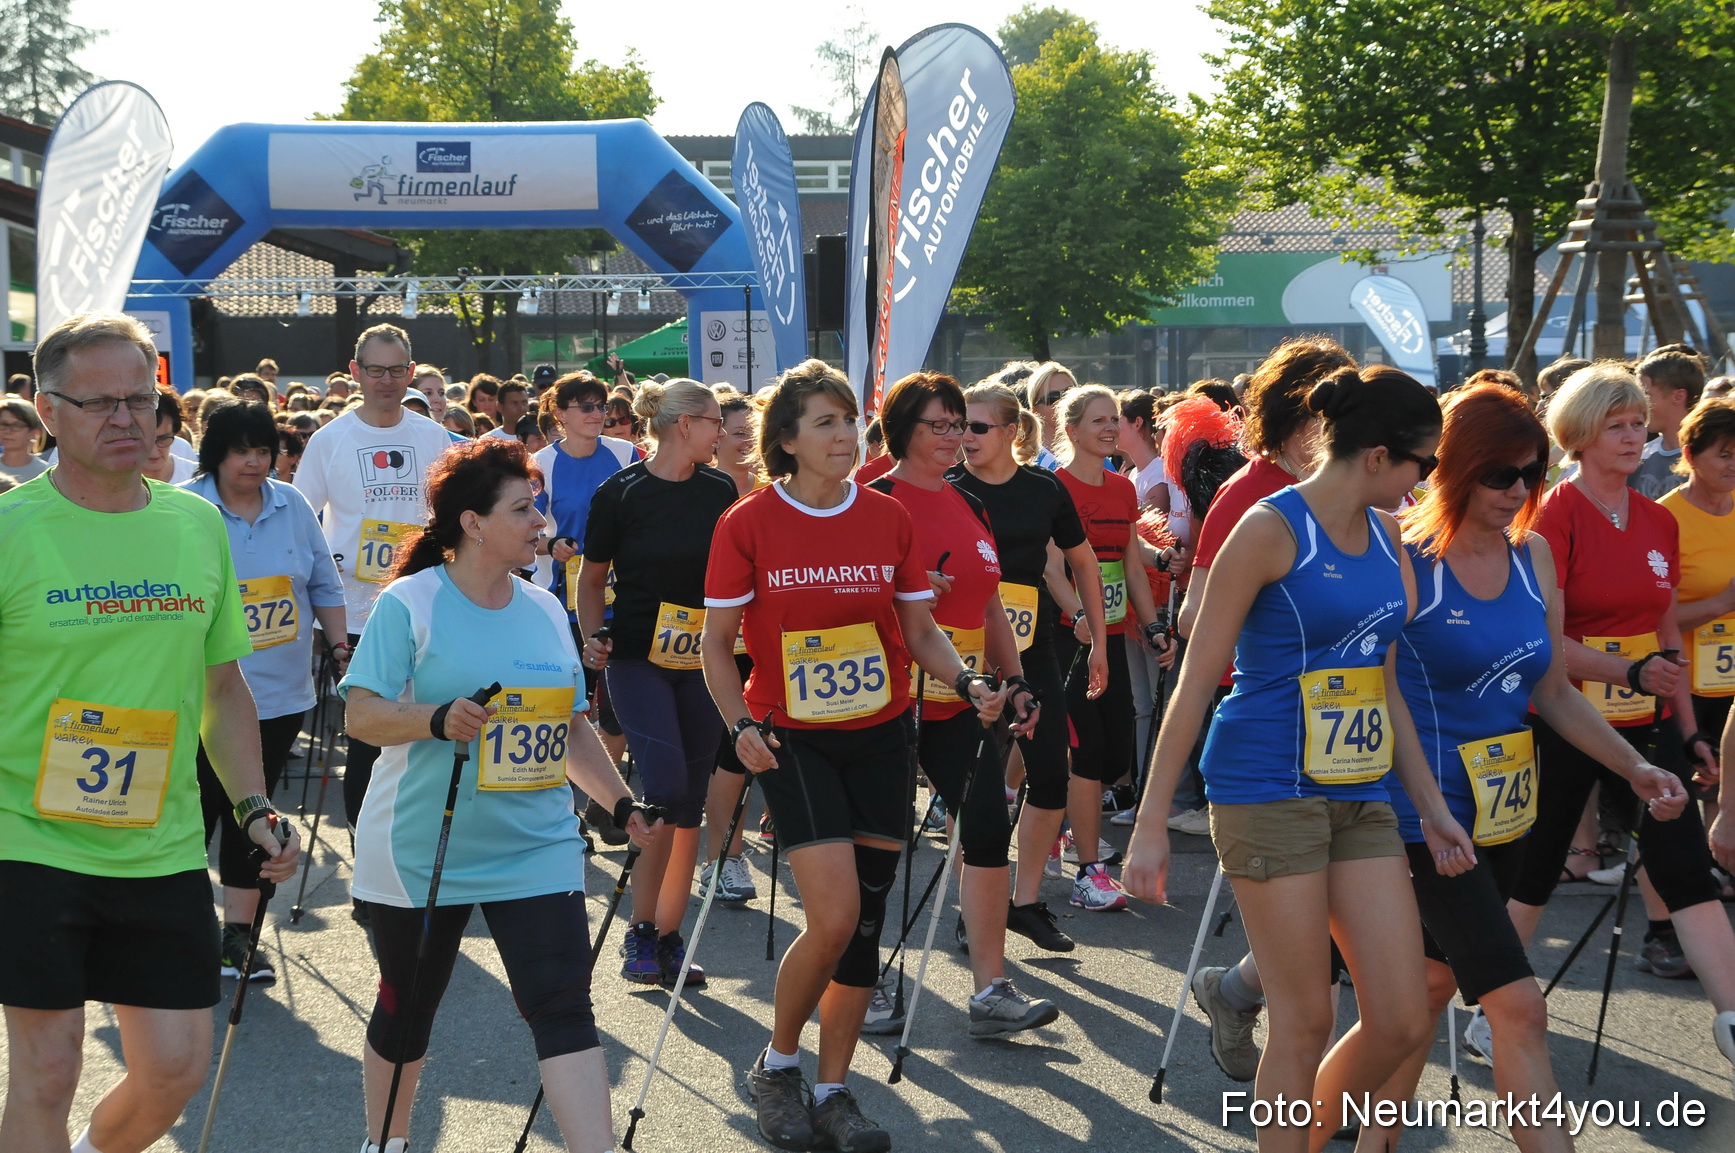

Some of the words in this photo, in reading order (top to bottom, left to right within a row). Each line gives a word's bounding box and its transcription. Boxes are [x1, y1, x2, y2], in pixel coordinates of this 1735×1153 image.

[428, 153, 468, 162] Fischer
[892, 67, 979, 269] Fischer
[398, 174, 518, 196] firmenlauf
[923, 103, 990, 264] AUTOMOBILE
[69, 118, 143, 288] Fischer
[398, 197, 447, 205] neumarkt
[161, 214, 229, 229] Fischer
[647, 214, 664, 225] und
[665, 212, 683, 221] das
[696, 220, 716, 229] mit!
[365, 486, 418, 498] POLGER
[362, 541, 405, 568] 10
[767, 565, 877, 588] NEUMARKT
[46, 580, 181, 604] autoladen
[86, 594, 206, 615] neumarkt
[49, 616, 90, 628] ersatzteil,
[93, 614, 115, 626] groß-
[117, 614, 133, 623] und
[243, 599, 295, 632] 372
[1329, 629, 1356, 652] Team
[1357, 606, 1386, 629] Schick
[1386, 599, 1404, 611] Bau
[798, 644, 836, 655] firmenlauf
[526, 662, 562, 672] sumida
[789, 657, 819, 666] walken
[1465, 670, 1491, 693] Team
[1492, 646, 1525, 670] Schick
[1525, 637, 1544, 650] Bau
[1715, 645, 1735, 674] 5
[789, 655, 885, 702] 1335
[1321, 687, 1357, 697] firmenlauf
[499, 704, 536, 713] firmenlauf
[1311, 701, 1341, 711] walken
[488, 715, 519, 724] walken
[70, 720, 121, 735] firmenlauf
[1320, 707, 1383, 755] 748
[54, 732, 93, 746] walken
[485, 723, 568, 764] 1388
[76, 747, 137, 796] 31
[1476, 768, 1503, 780] walken
[83, 795, 108, 805] Rainer
[108, 797, 127, 806] Ulrich
[1486, 767, 1531, 820] 743
[75, 806, 111, 816] Autoladen
[111, 807, 128, 816] GmbH
